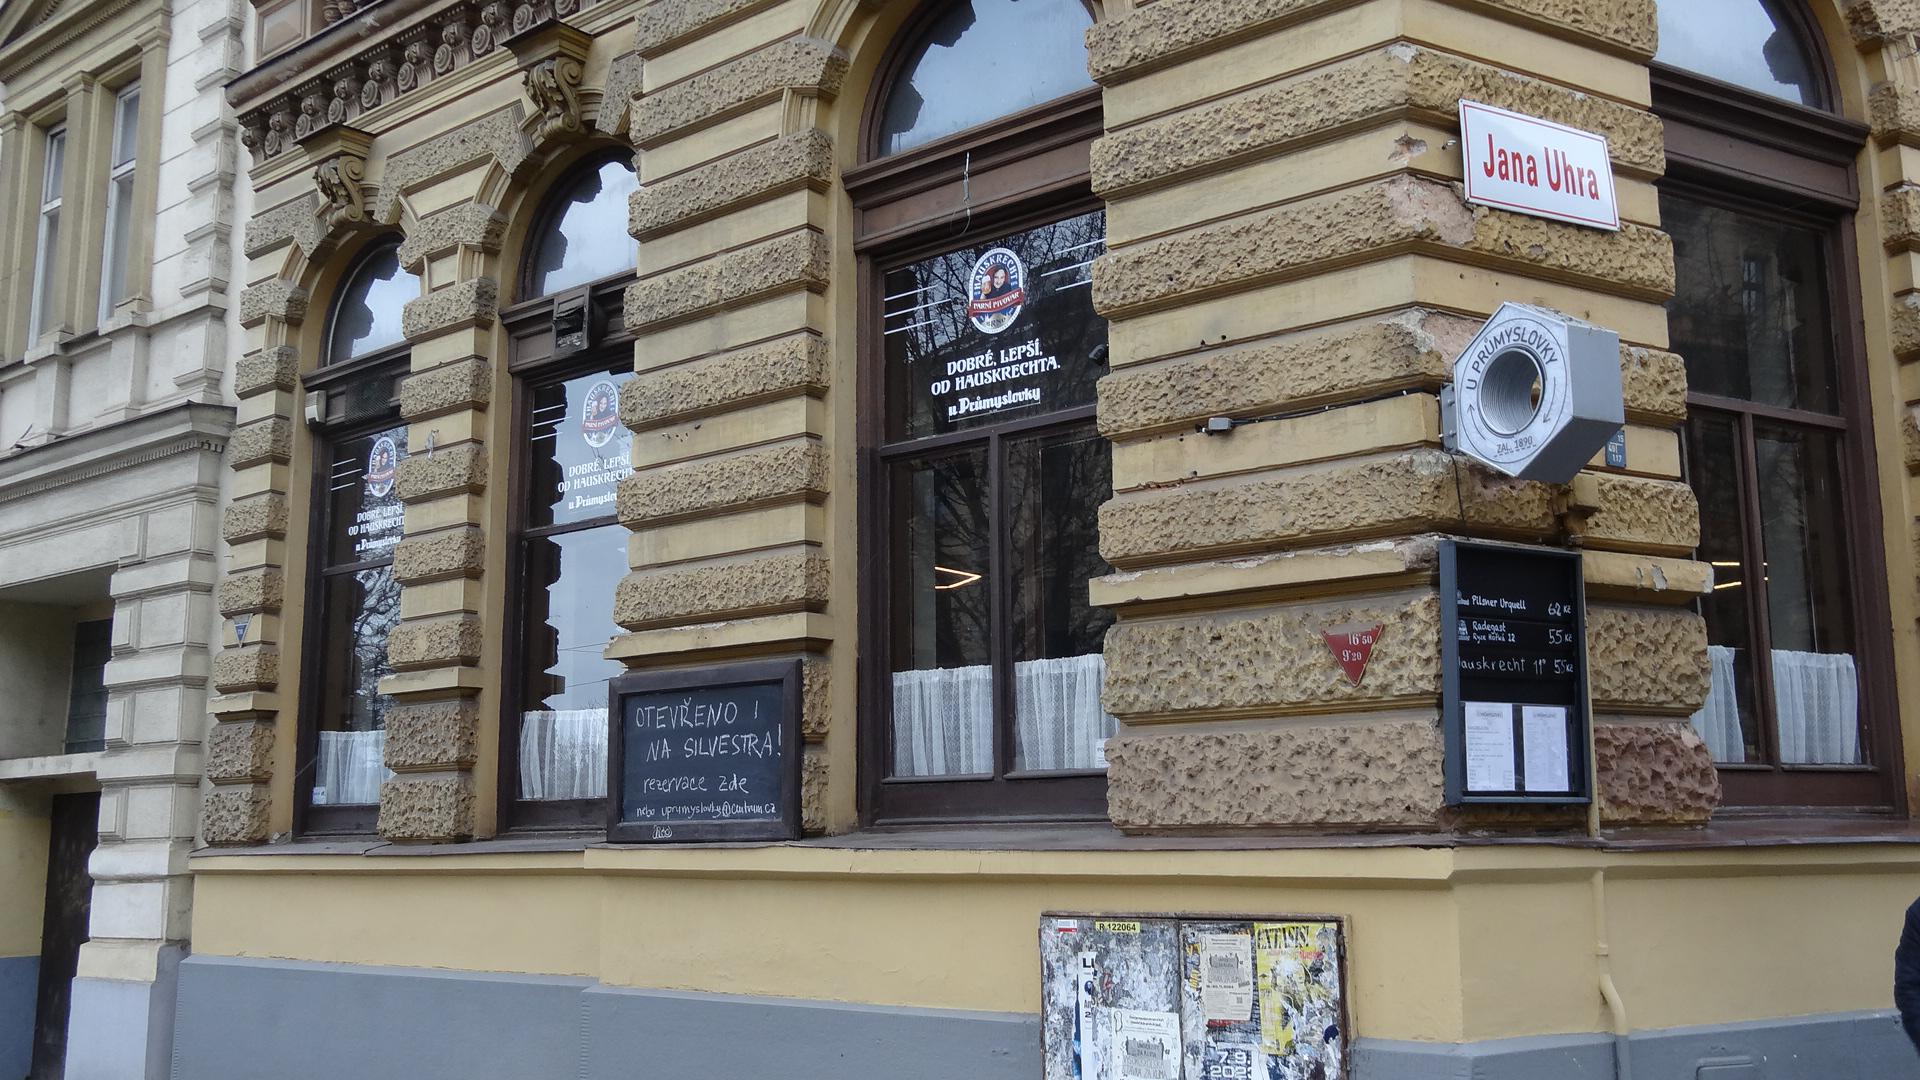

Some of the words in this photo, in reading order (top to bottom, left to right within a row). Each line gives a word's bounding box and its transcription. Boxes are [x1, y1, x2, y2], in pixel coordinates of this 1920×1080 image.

[1483, 133, 1538, 188] Jana
[1544, 146, 1600, 200] Uhra
[947, 349, 997, 376] DOBRÉ,
[1466, 378, 1478, 391] U
[1472, 326, 1558, 375] PRŮMYSLOVKY
[931, 380, 951, 396] OD
[955, 356, 1061, 391] HAUSKRECHTA.
[949, 406, 957, 417] u
[959, 388, 1040, 414] Průmyslovky
[1514, 436, 1533, 449] 1890
[557, 481, 571, 493] OD
[574, 467, 635, 490] HAUSKRECHT
[348, 525, 359, 536] OD
[1471, 594, 1498, 607] Pilsner
[1500, 598, 1526, 614] Urquell
[1547, 602, 1561, 616] 62
[1472, 620, 1506, 635] Radegast
[1548, 628, 1562, 645] 55
[1458, 656, 1526, 673] auskrecht
[636, 697, 738, 729] OTEVŘENO
[646, 738, 671, 762] NA
[684, 723, 782, 759] SILVESTRA!
[643, 775, 707, 794] rezervace
[636, 804, 655, 817] nebo
[1107, 923, 1136, 932] 122064
